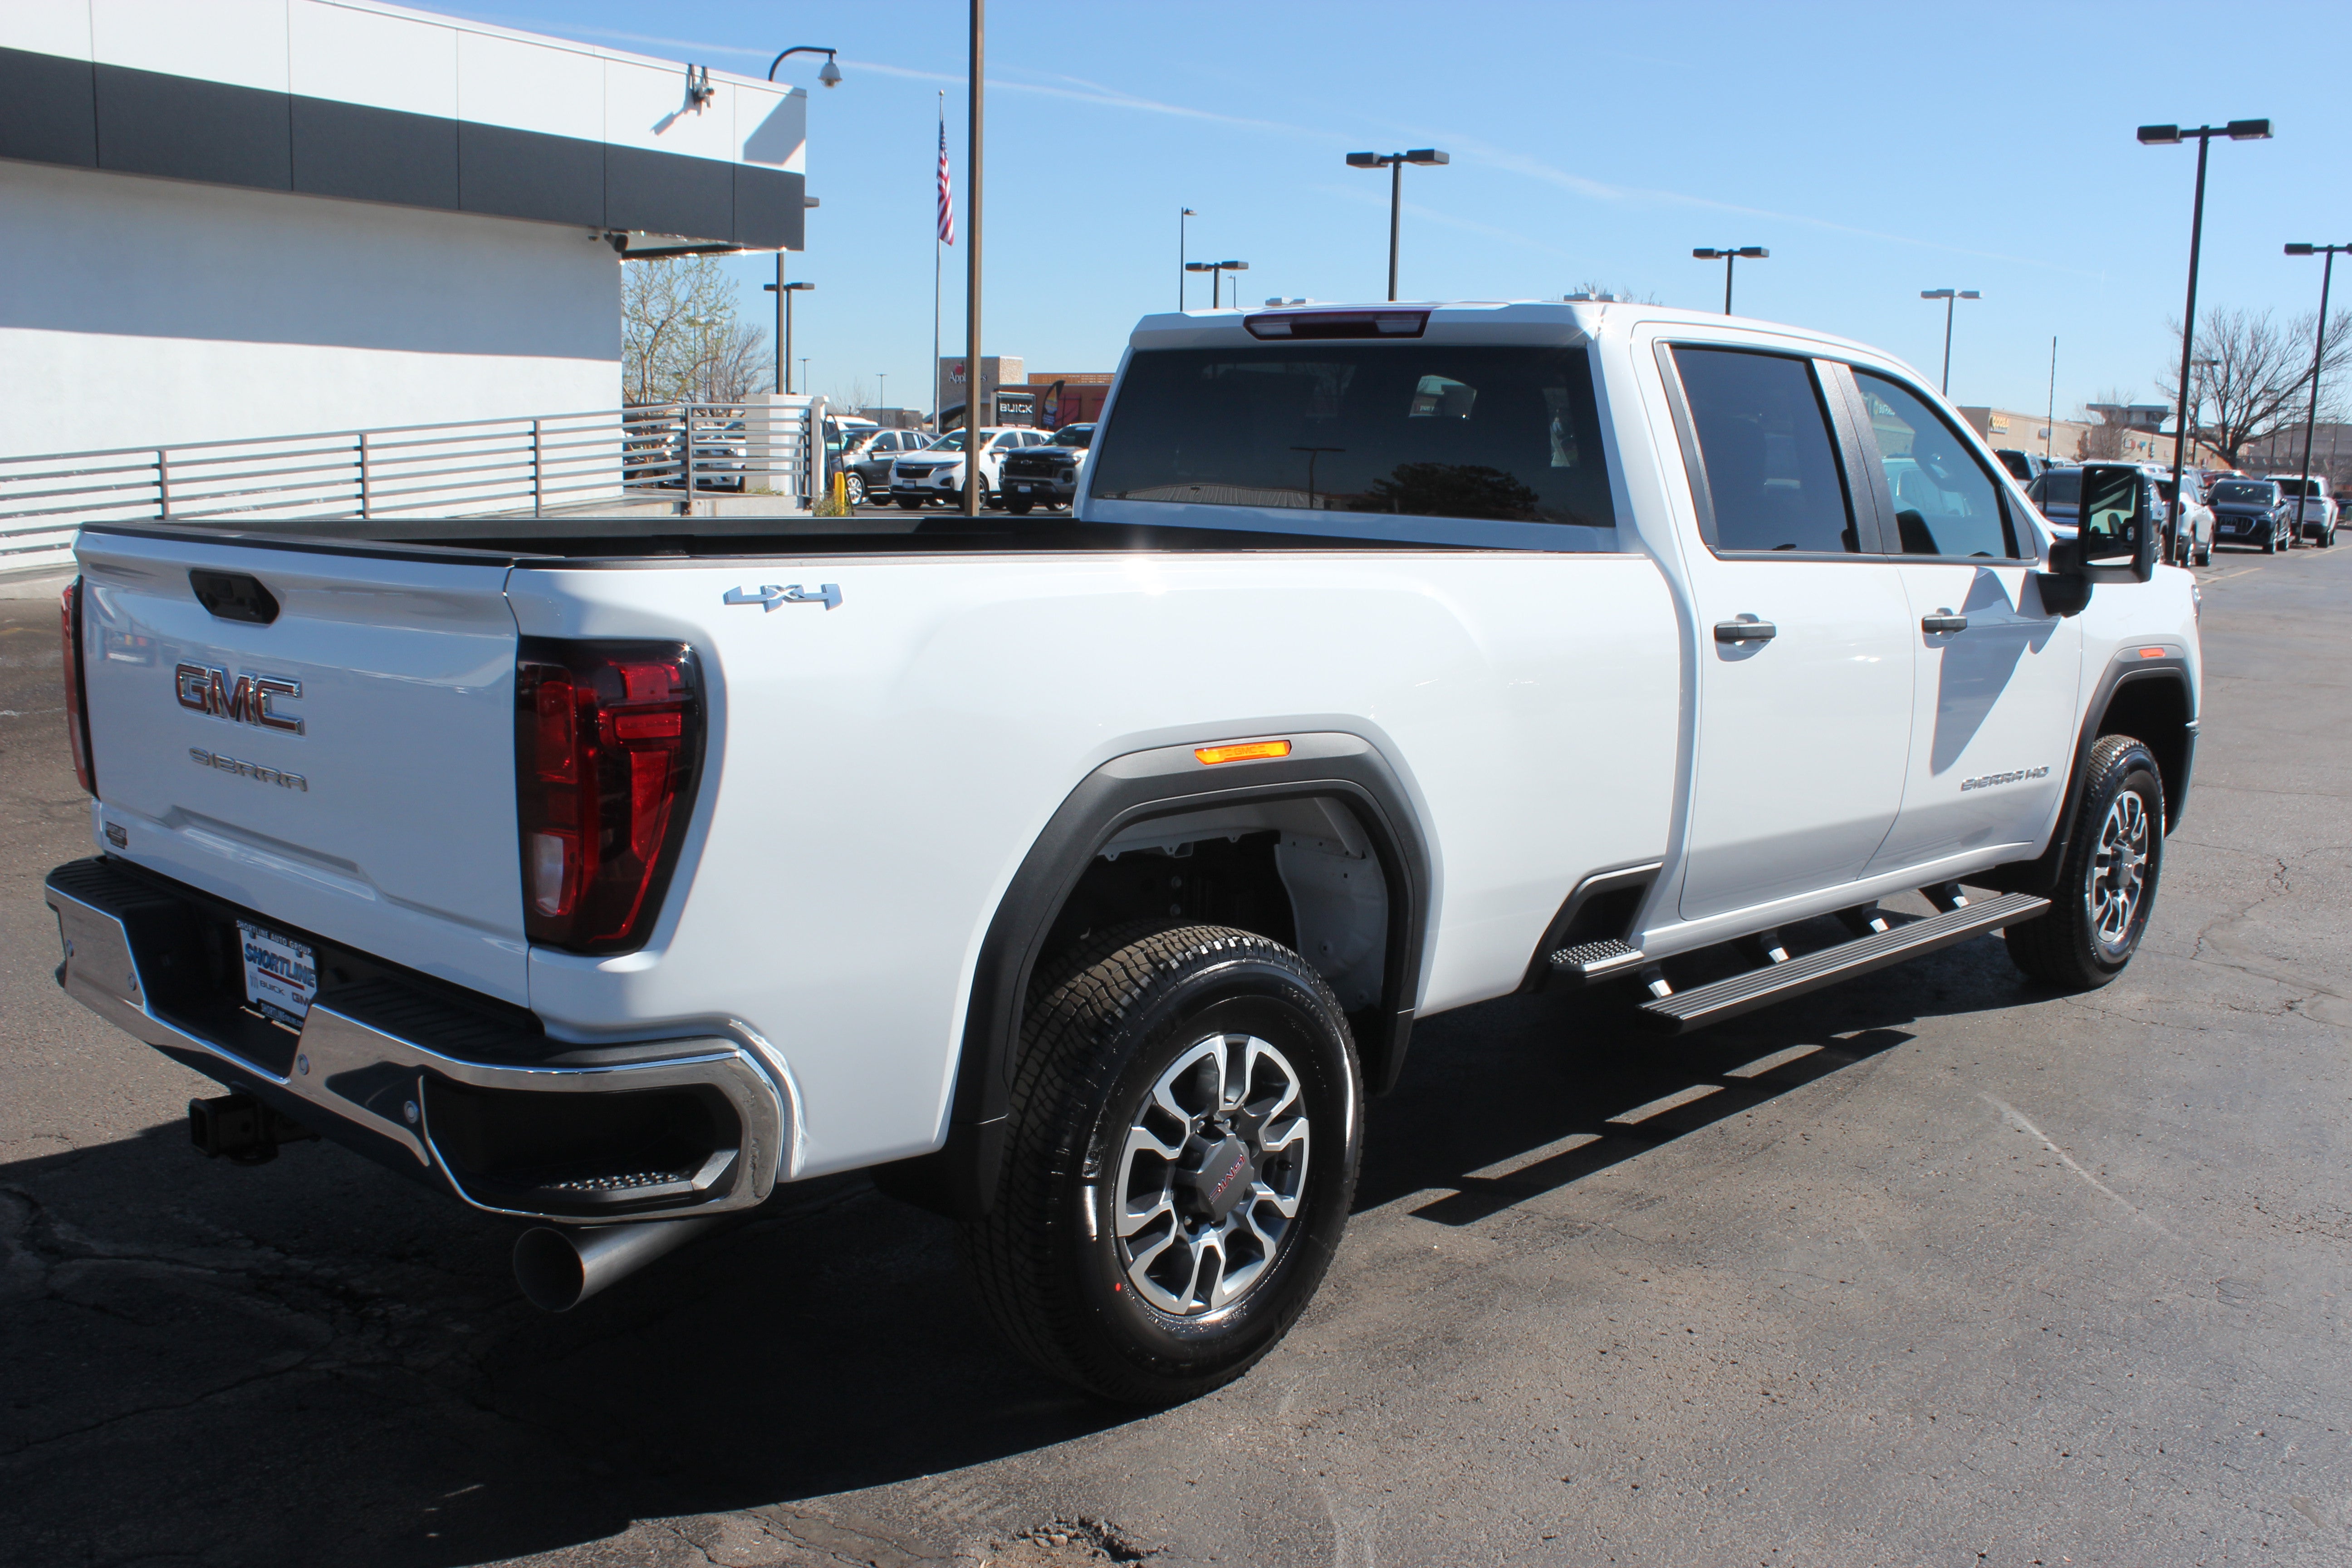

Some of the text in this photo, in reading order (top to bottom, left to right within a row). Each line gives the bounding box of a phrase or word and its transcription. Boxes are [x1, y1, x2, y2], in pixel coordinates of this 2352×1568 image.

[1000, 403, 1033, 414] BUICK
[175, 659, 306, 737] GMC
[1234, 746, 1257, 755] GMC
[189, 746, 308, 792] SIERRA
[1960, 766, 2050, 792] SIERRA HD
[236, 920, 312, 956] SHORTLINE AUTO GROUP
[245, 942, 316, 989] SHORTLINE
[260, 980, 285, 996] BUICK
[292, 991, 312, 1007] GM
[1209, 1154, 1245, 1205] GMC
